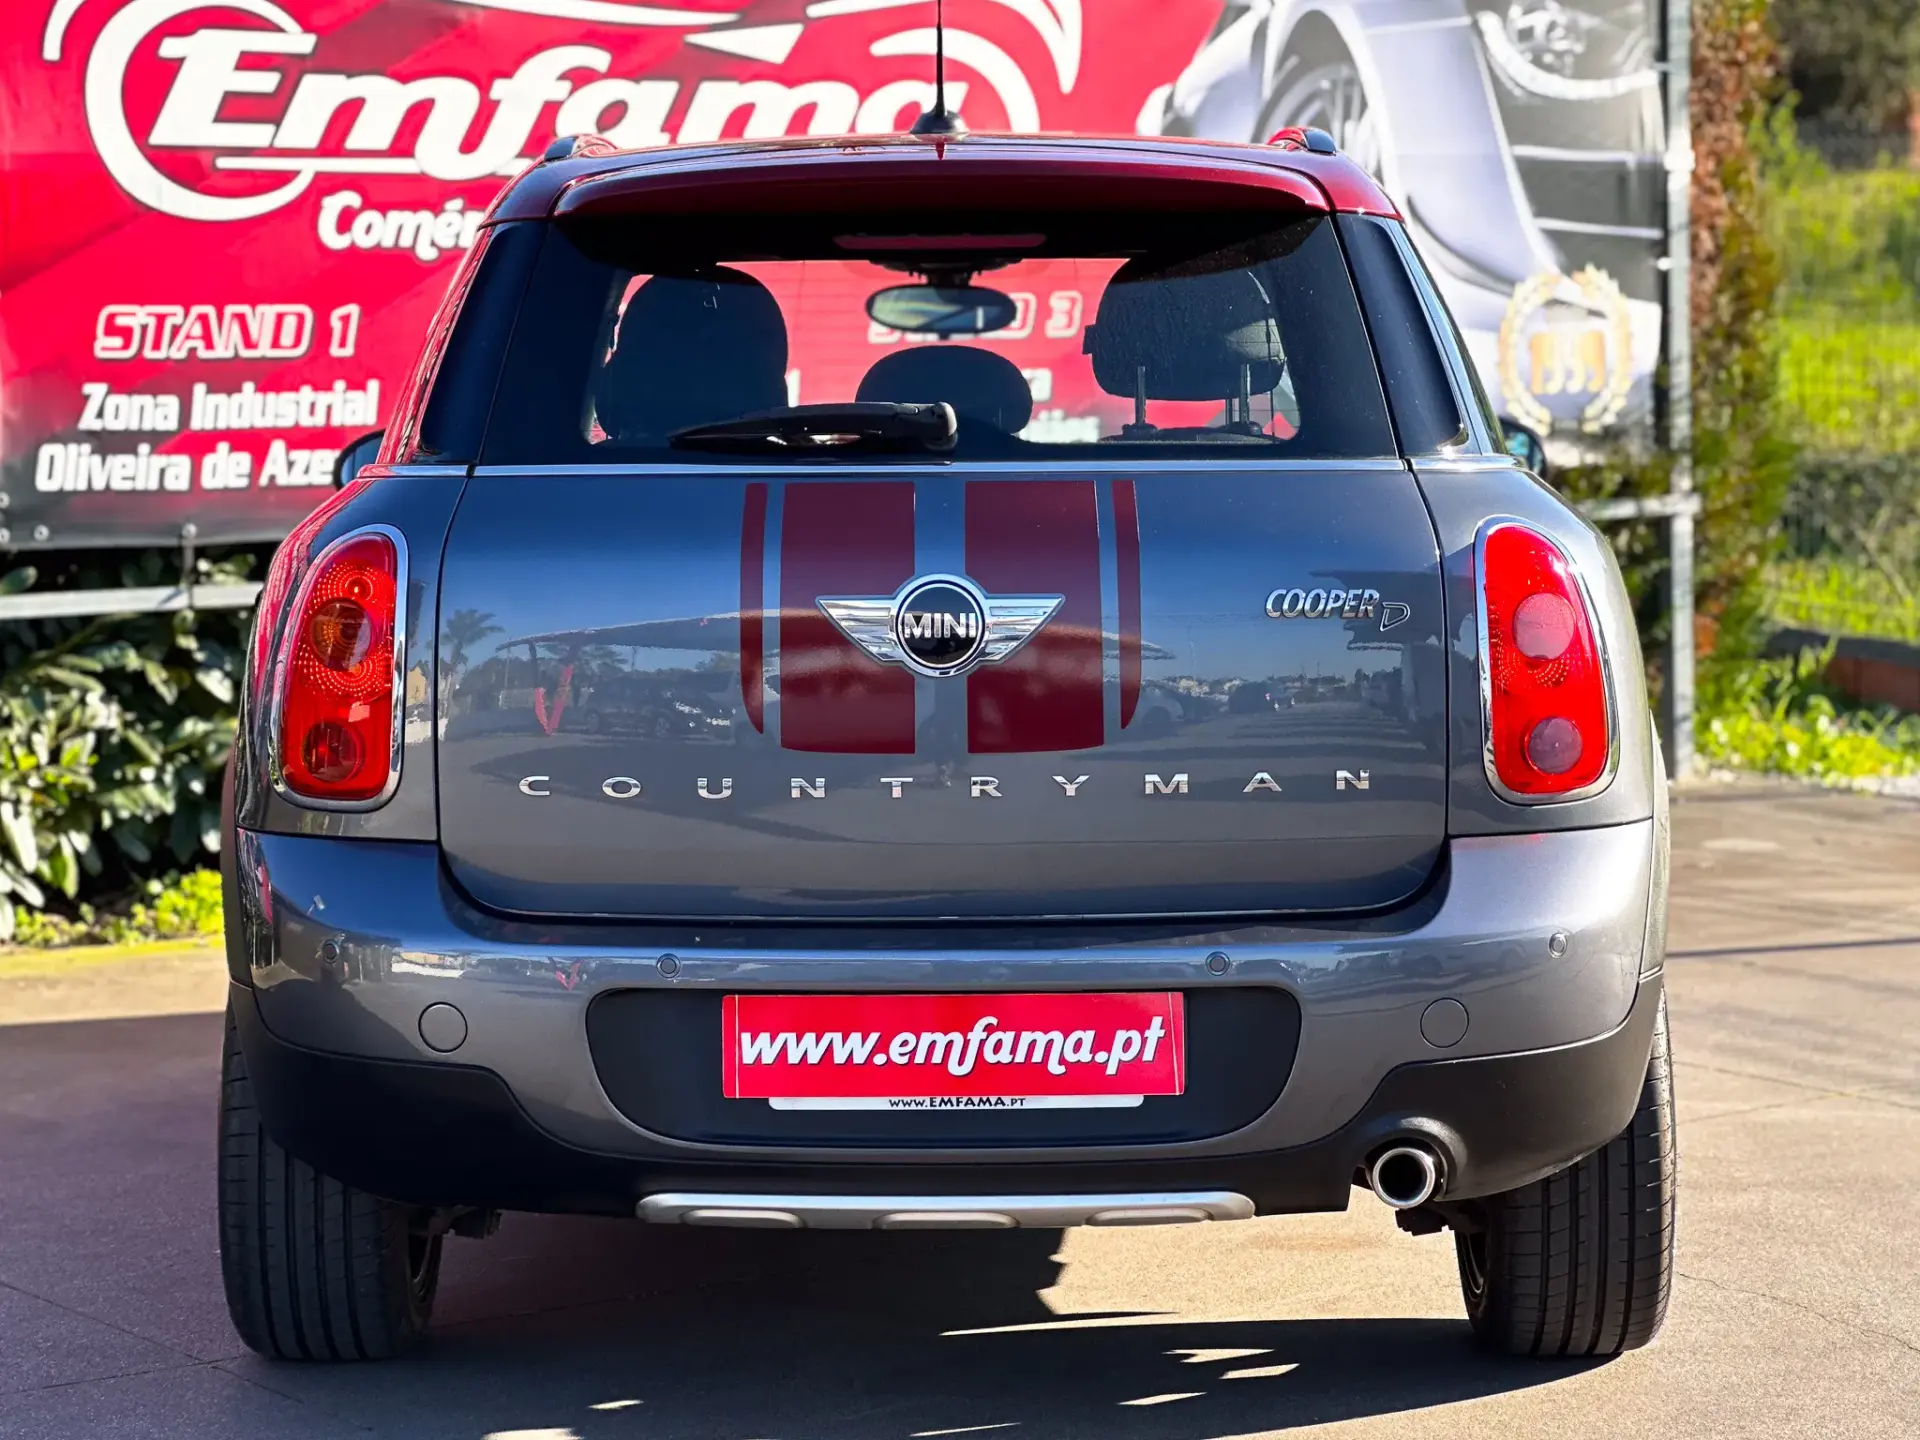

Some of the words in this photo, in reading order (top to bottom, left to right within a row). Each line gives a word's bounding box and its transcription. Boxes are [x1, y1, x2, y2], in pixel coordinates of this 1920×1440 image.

[148, 28, 972, 180] Emfama
[94, 303, 314, 360] STAND
[329, 302, 361, 358] 1
[77, 382, 180, 431] Zona
[190, 378, 381, 430] Industrial
[35, 443, 192, 492] Oliveira
[201, 440, 251, 490] de
[259, 439, 341, 488] Aze
[903, 612, 977, 640] MINI
[1265, 588, 1380, 619] COOPER
[1380, 601, 1412, 632] D
[518, 769, 1371, 799] COUNTRYMAN
[740, 1016, 1166, 1077] www.emfama.pt
